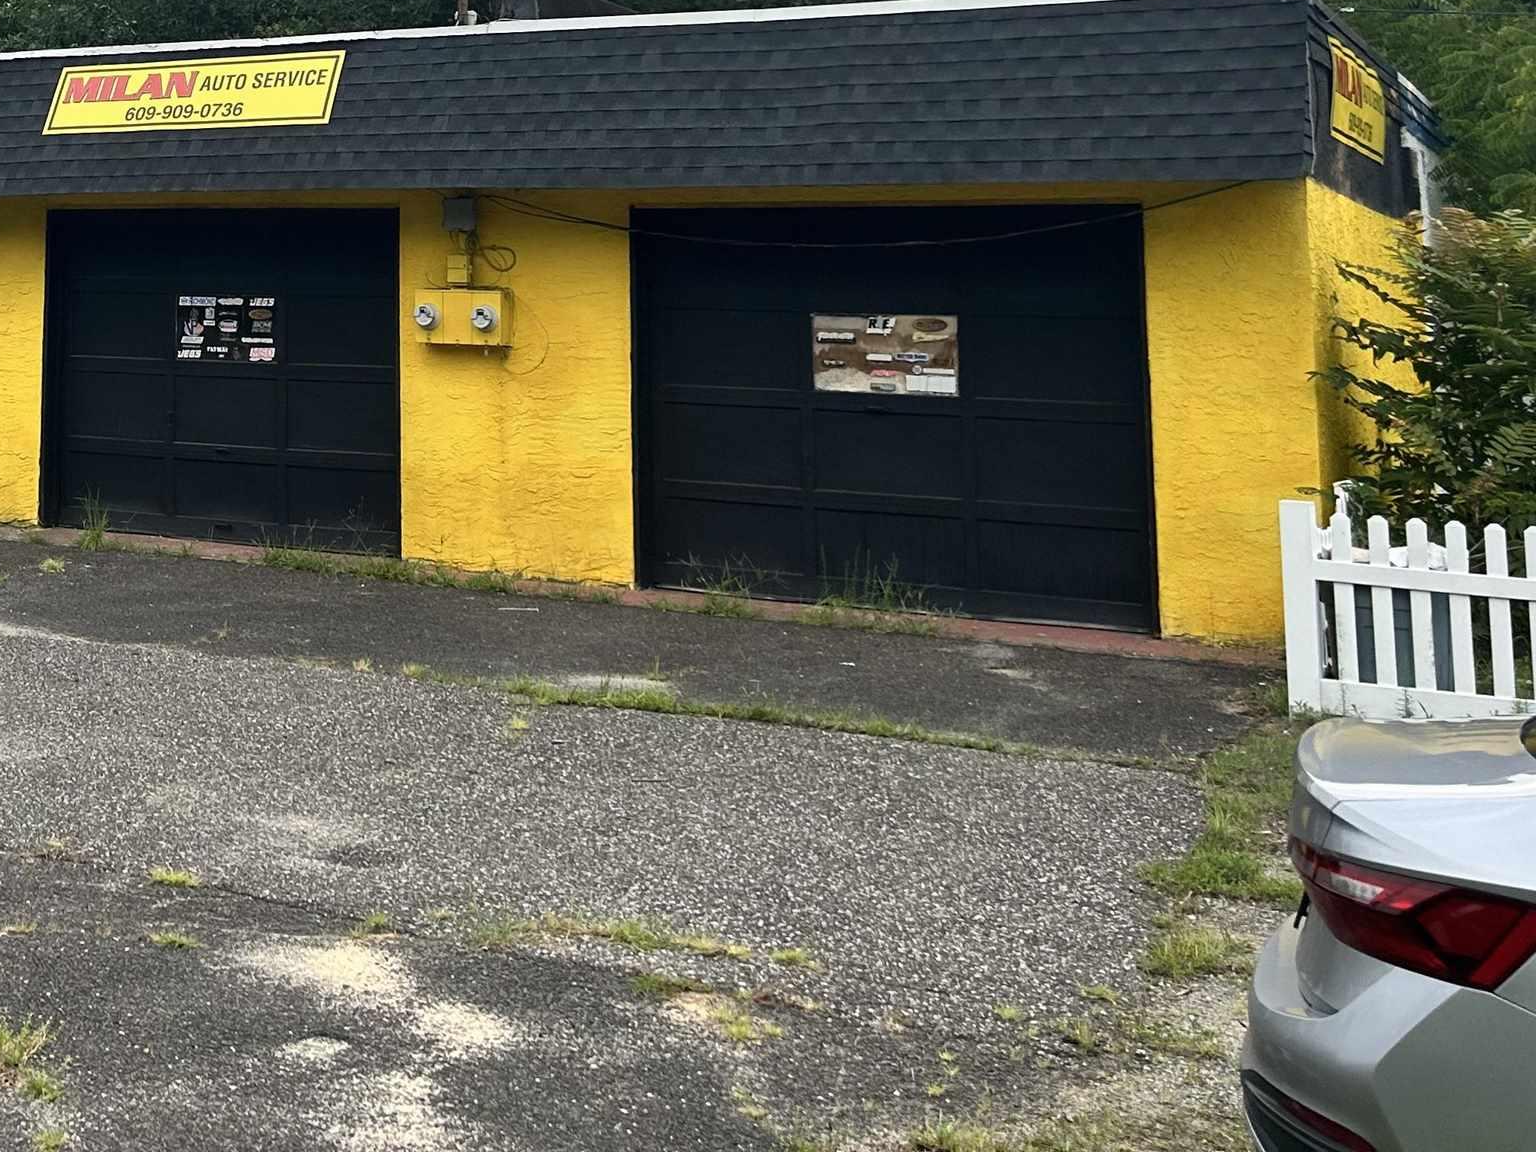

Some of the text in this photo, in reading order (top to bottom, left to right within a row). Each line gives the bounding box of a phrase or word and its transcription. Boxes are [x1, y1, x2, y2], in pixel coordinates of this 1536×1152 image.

[62, 69, 329, 104] MILAN AUTO SERVICE
[125, 102, 244, 121] 609-909-0736
